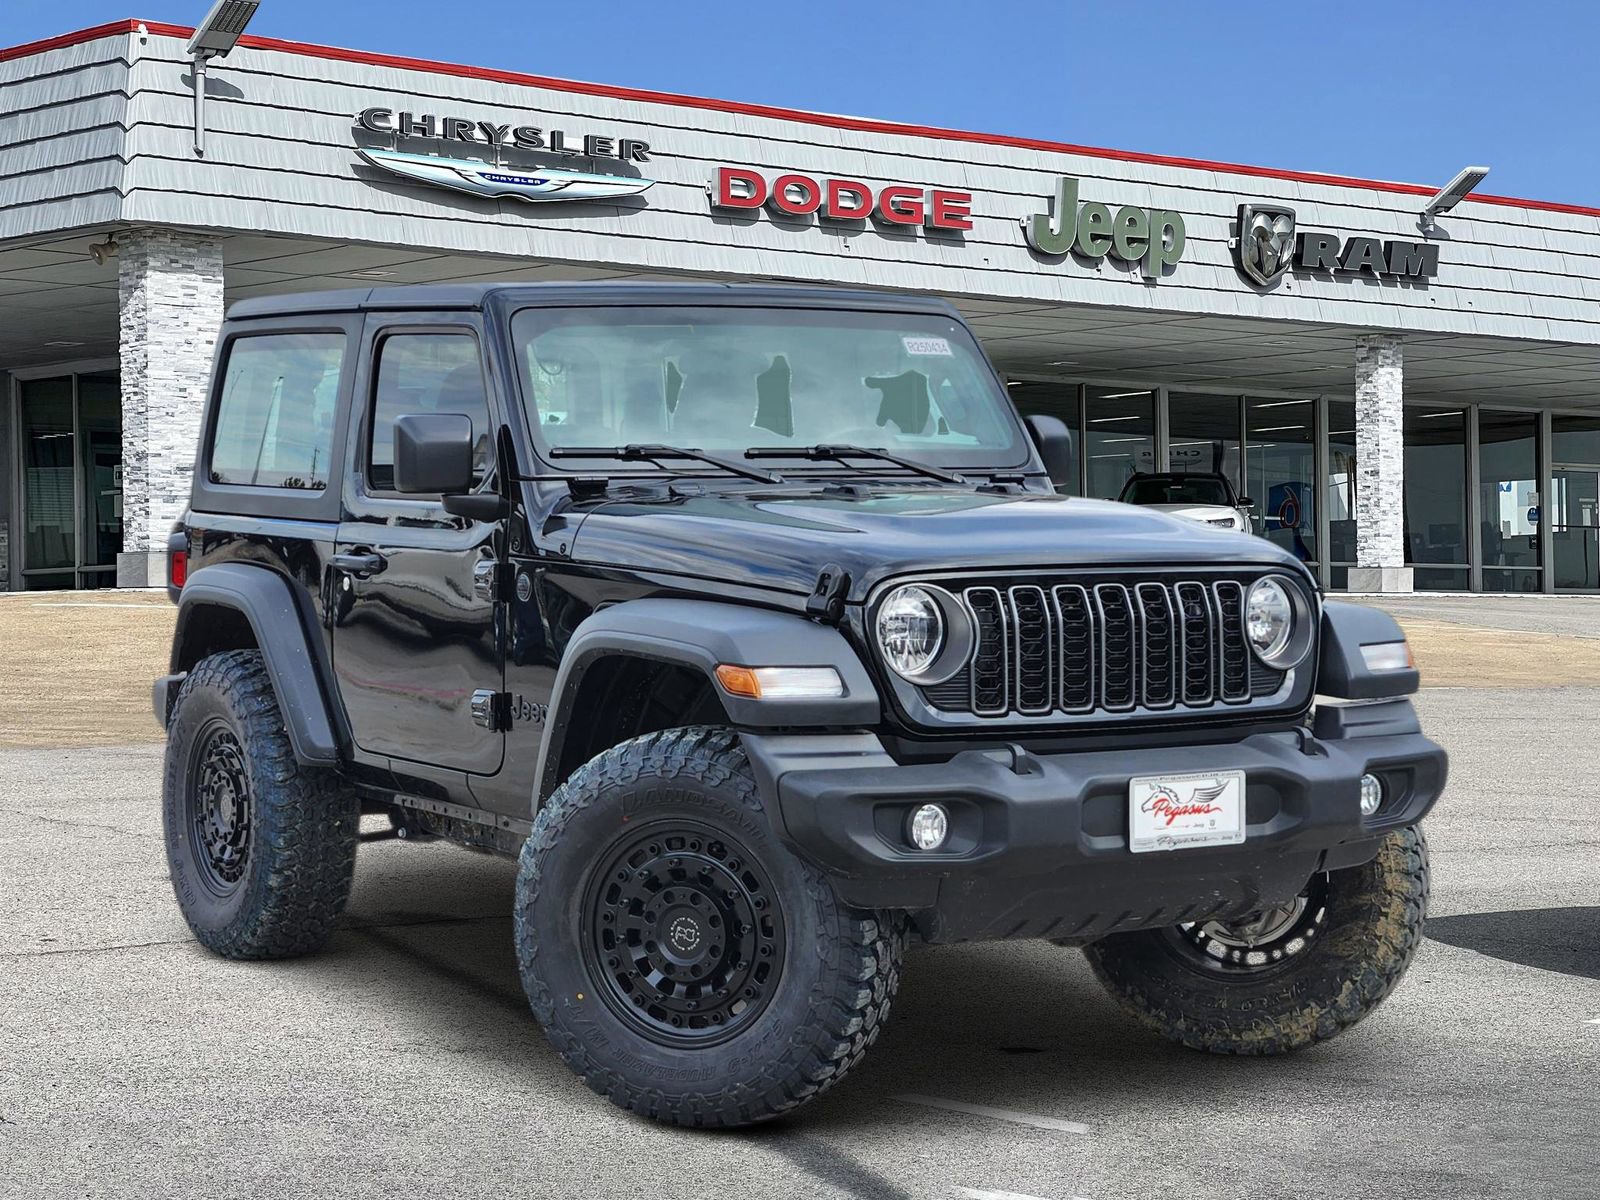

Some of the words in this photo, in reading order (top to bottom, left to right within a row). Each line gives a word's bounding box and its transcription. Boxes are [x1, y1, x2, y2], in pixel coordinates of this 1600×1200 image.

[358, 107, 651, 162] CHRYSLER
[484, 174, 541, 185] CHRYSLER
[713, 166, 974, 231] DODGE
[1028, 176, 1186, 279] Jeep
[1299, 232, 1440, 277] RAM
[1151, 798, 1223, 826] Pegasus
